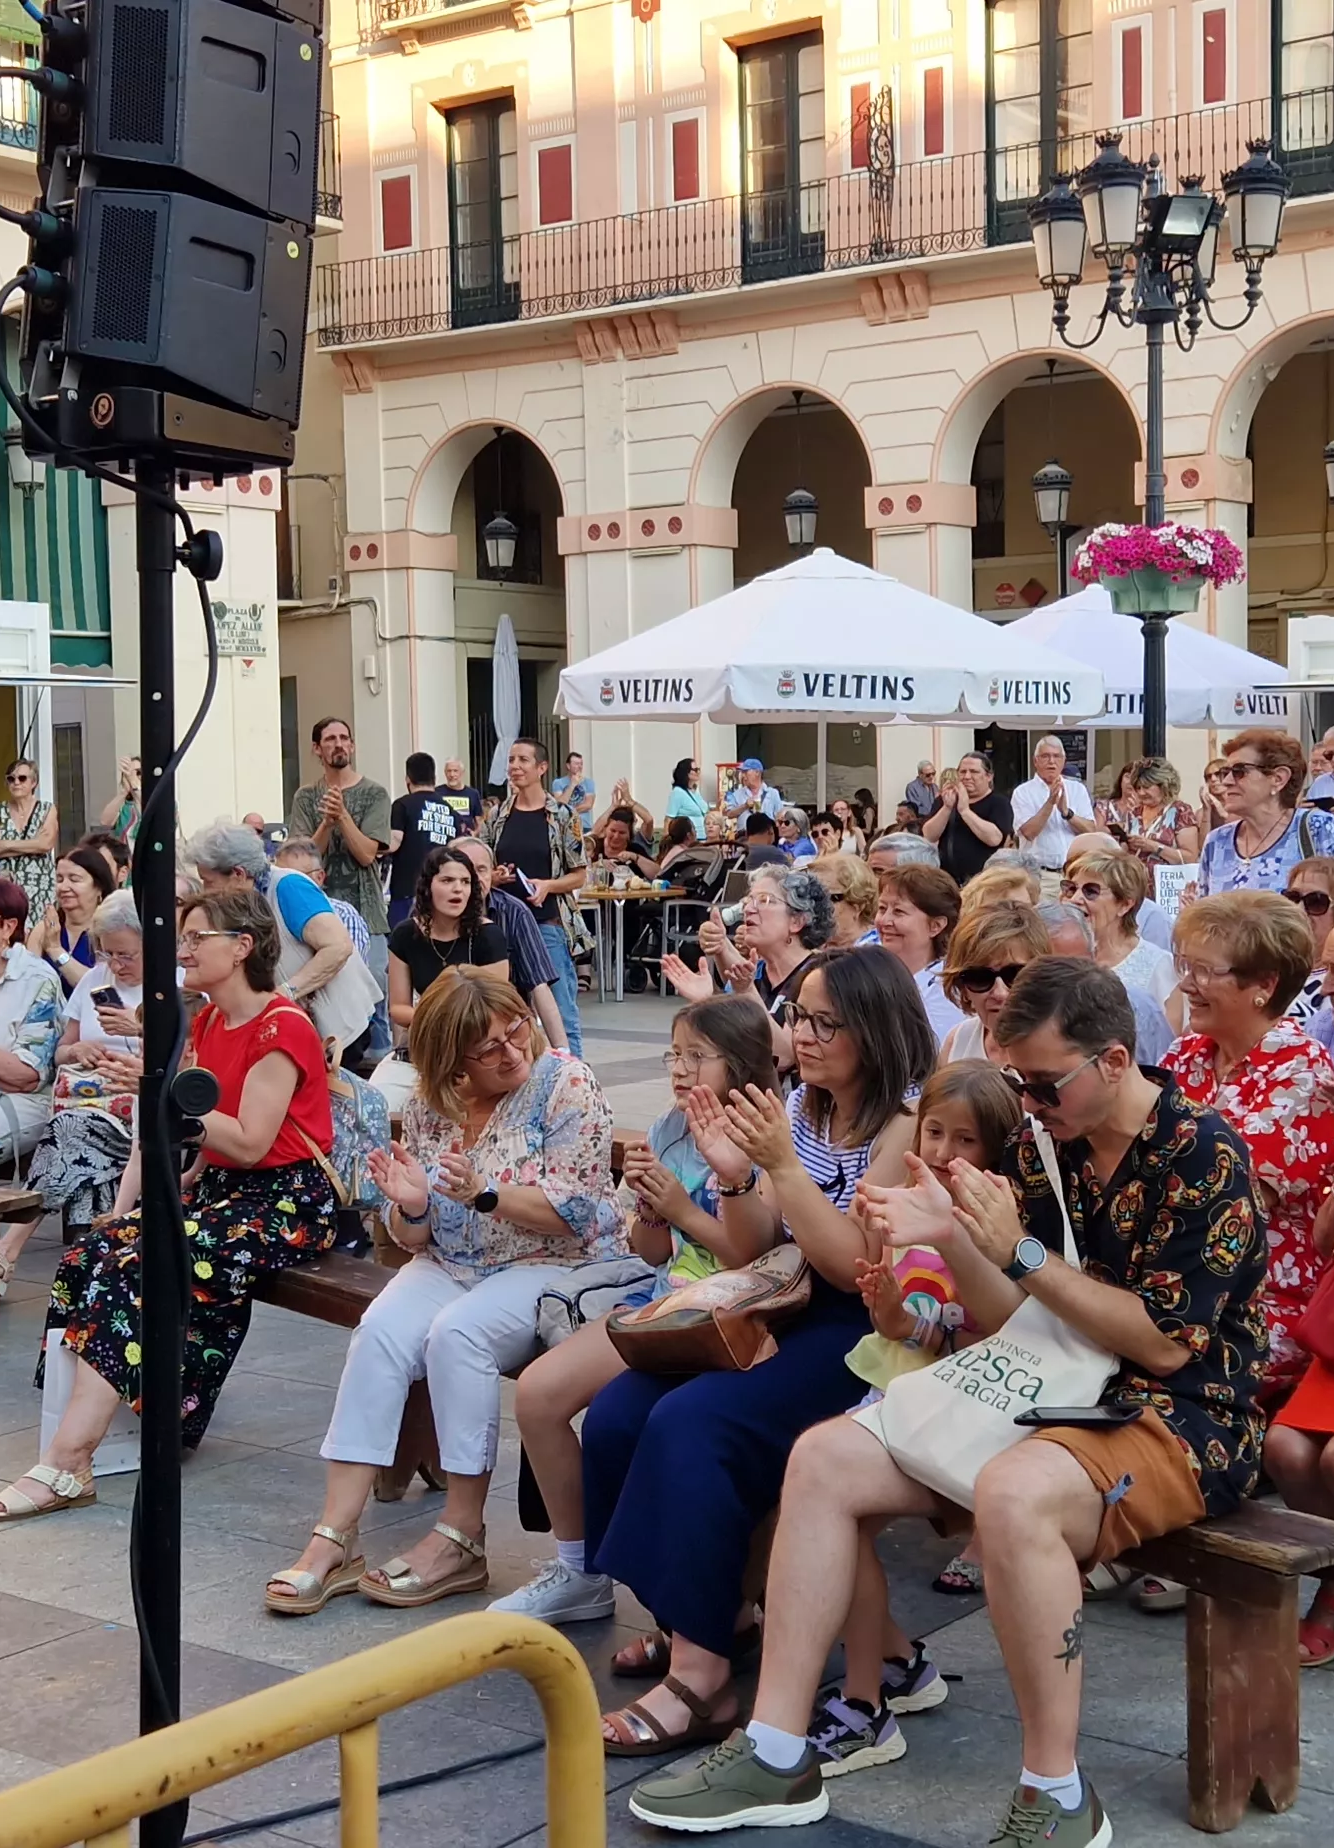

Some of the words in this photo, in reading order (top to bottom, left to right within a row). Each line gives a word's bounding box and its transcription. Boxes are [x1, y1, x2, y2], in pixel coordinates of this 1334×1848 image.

[619, 678, 693, 703] VELTINS
[803, 672, 915, 701] VELTINS
[1003, 680, 1071, 705] VELTINS
[1247, 695, 1288, 716] VELTI
[1160, 872, 1185, 880] FERIA
[1160, 881, 1175, 889] DEL
[1160, 889, 1179, 898] LIBR
